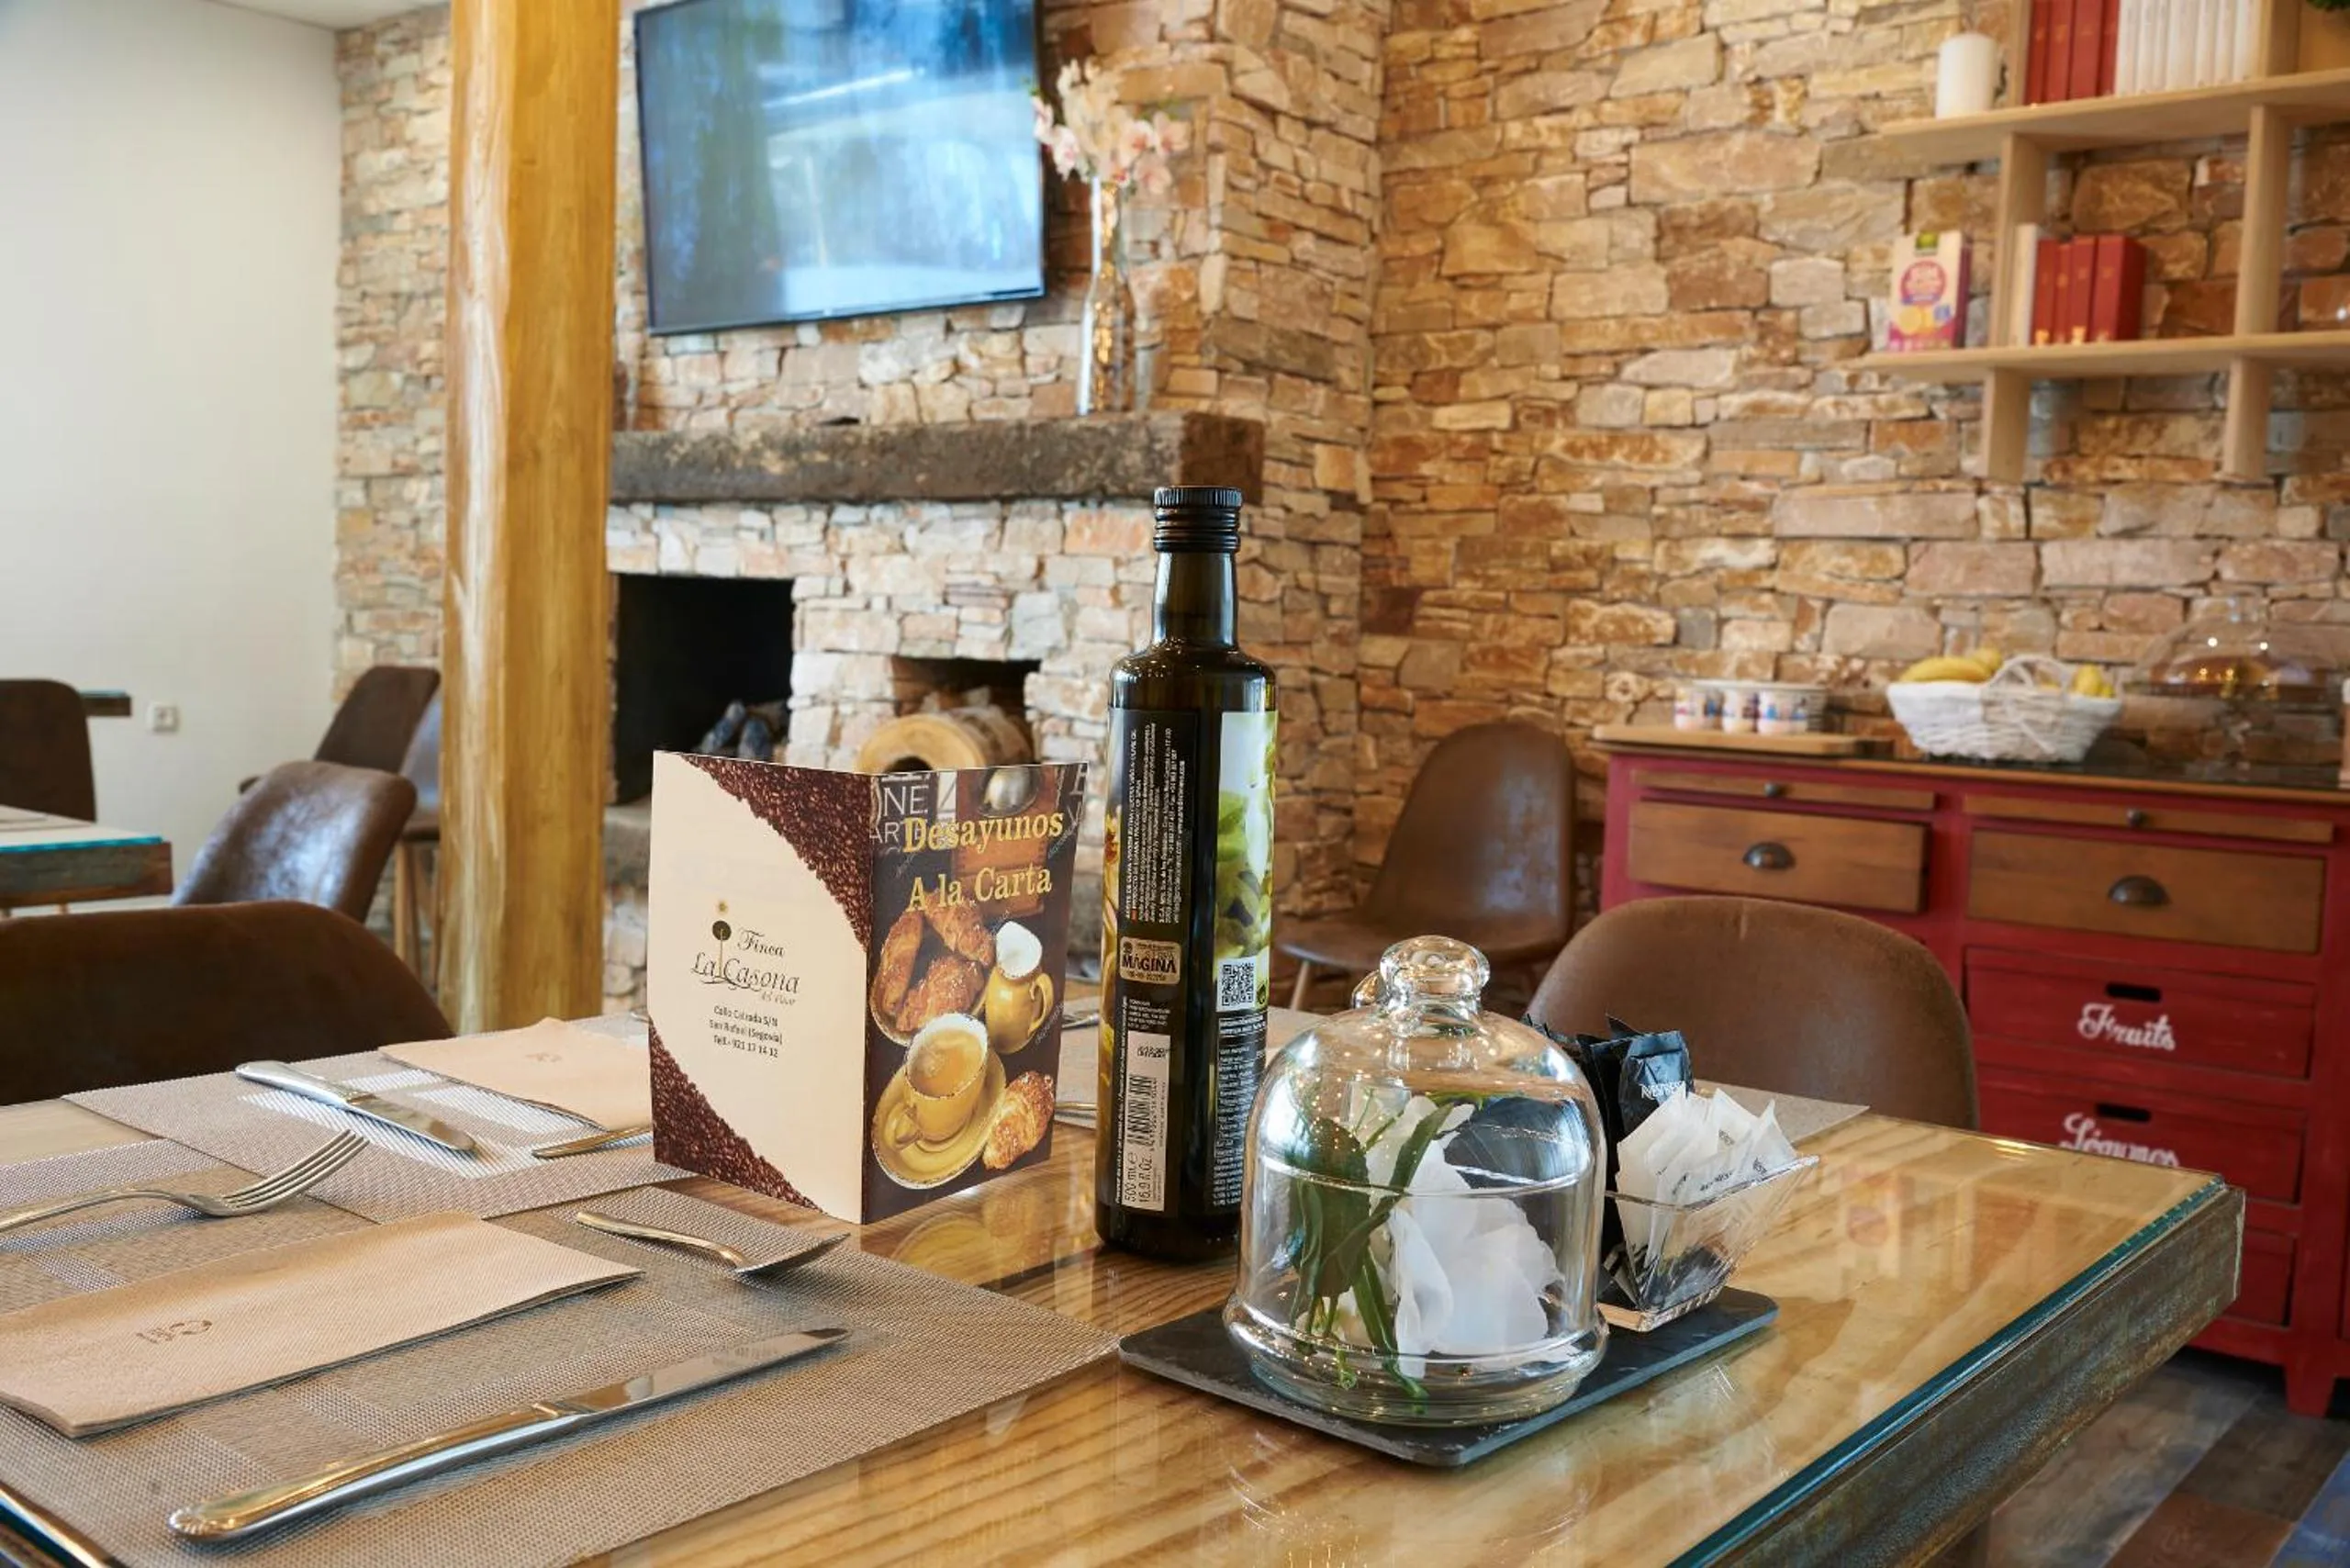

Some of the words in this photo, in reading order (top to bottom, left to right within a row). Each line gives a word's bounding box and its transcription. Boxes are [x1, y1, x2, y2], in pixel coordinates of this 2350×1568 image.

[902, 812, 1064, 854] Desayunos
[905, 876, 927, 913] A
[937, 873, 964, 908] la
[975, 862, 1053, 902] Carta
[736, 927, 785, 958] Finca
[690, 951, 717, 978] La
[722, 958, 800, 994] Casona
[2077, 1002, 2176, 1051] Fruits
[1124, 1182, 1137, 1203] 500
